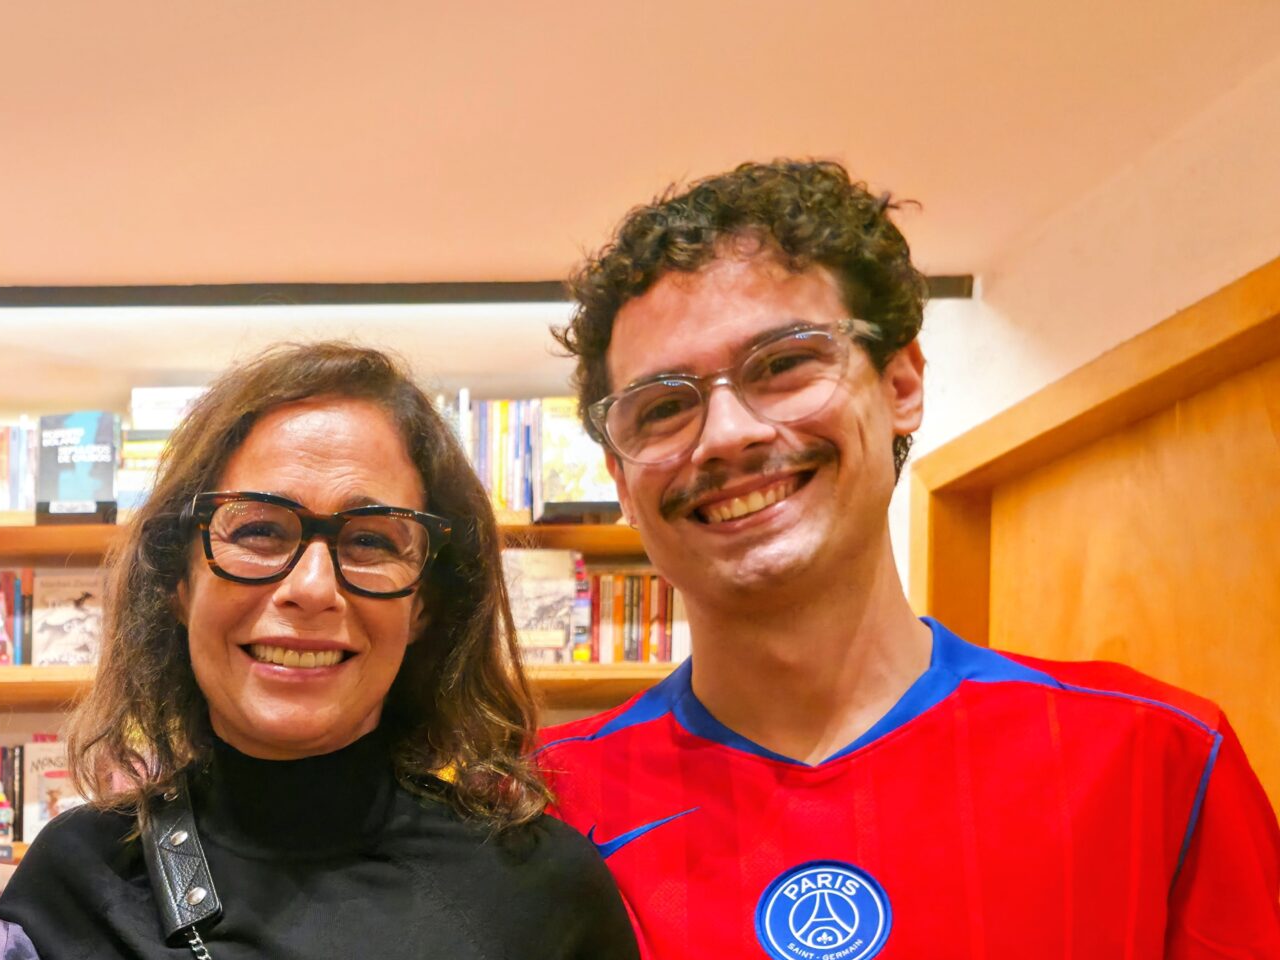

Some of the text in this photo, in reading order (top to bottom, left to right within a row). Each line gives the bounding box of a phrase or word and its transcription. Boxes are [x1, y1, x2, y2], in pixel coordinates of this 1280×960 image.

[783, 873, 860, 900] PARIS
[787, 942, 814, 960] SAINT
[822, 939, 864, 960] GERMAIN
